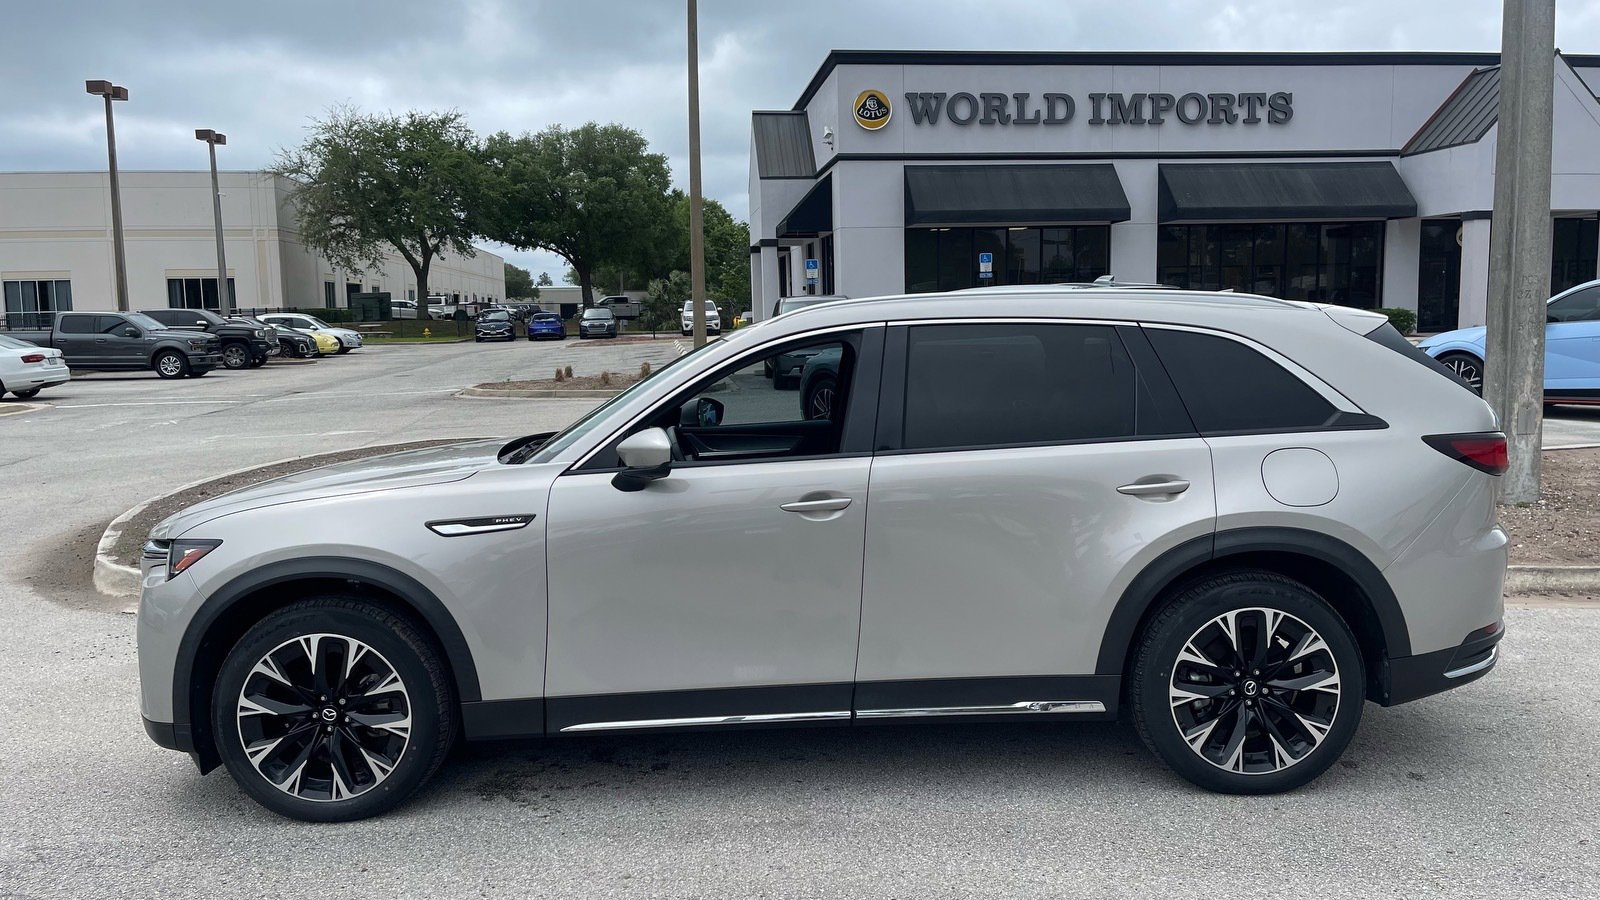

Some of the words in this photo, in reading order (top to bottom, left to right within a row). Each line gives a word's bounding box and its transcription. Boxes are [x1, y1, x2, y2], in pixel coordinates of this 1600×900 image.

[859, 107, 888, 118] LOTUS
[904, 92, 1076, 126] WORLD
[1087, 92, 1294, 125] IMPORTS
